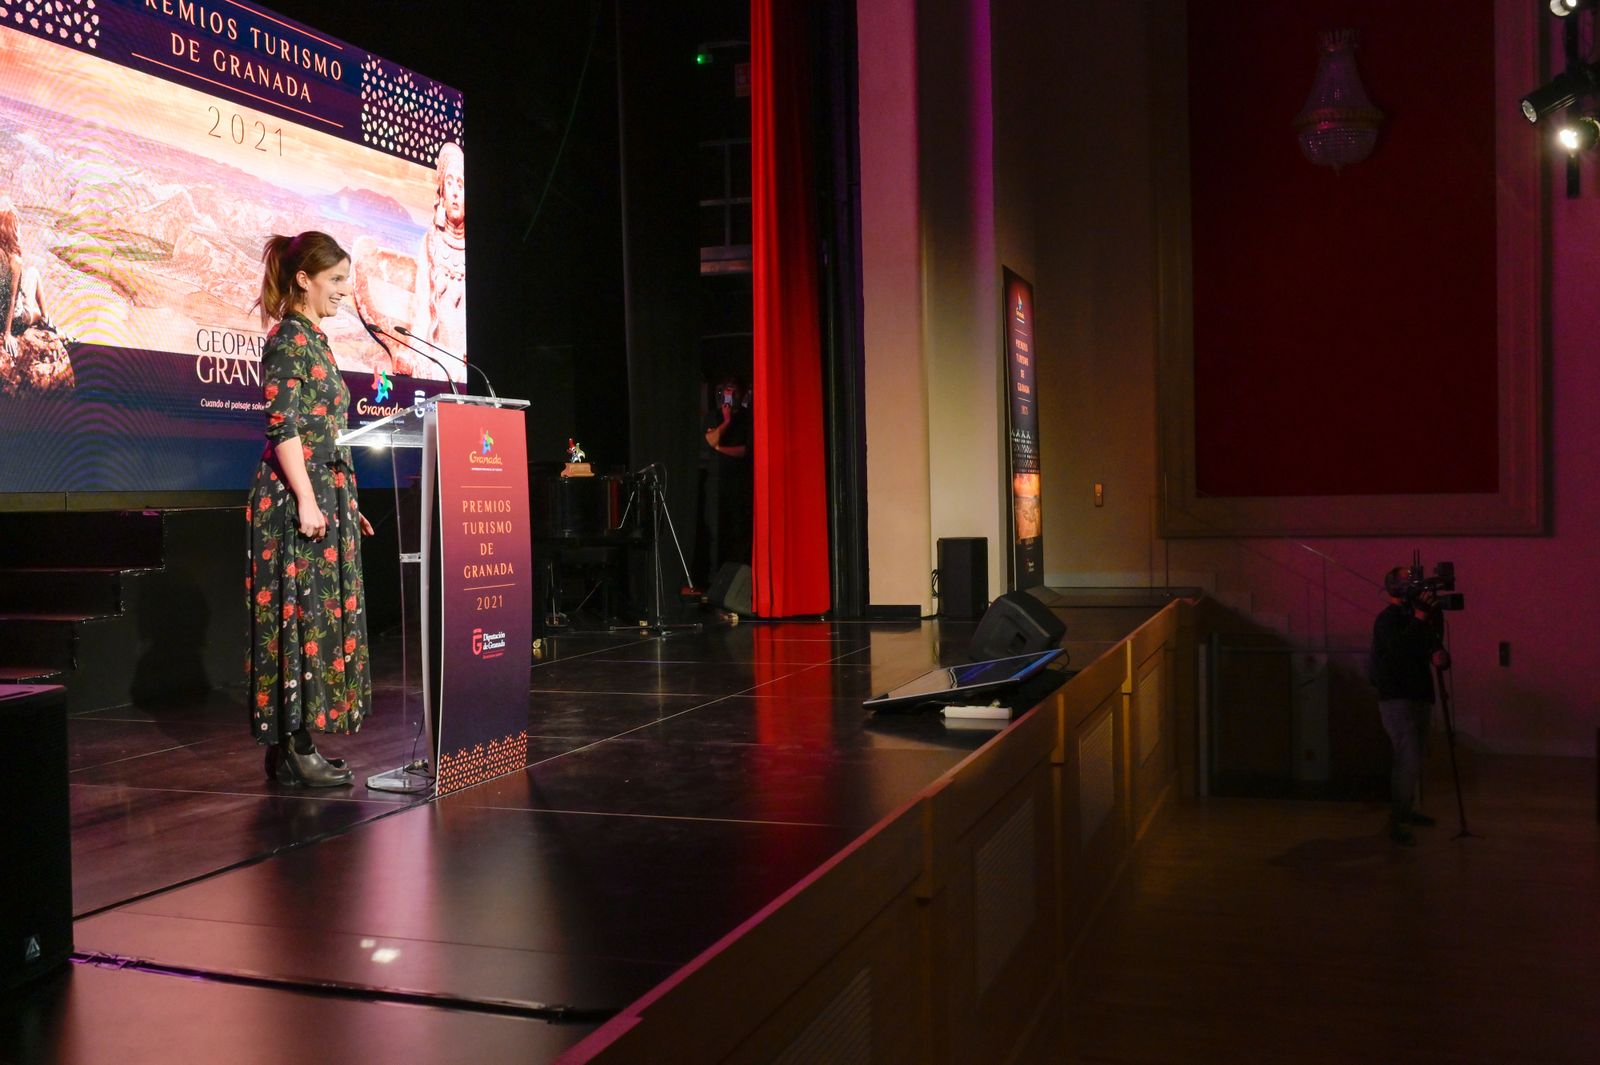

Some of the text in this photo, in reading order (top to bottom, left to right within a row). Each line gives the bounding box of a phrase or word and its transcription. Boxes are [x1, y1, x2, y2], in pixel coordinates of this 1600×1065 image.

[250, 27, 342, 81] TURISMO
[170, 32, 312, 104] DE GRANADA
[208, 105, 283, 157] 2021
[196, 355, 264, 388] GRAN
[200, 398, 224, 408] Cuando
[224, 400, 231, 409] el
[231, 400, 252, 412] paisaje
[469, 450, 503, 465] Granada
[462, 499, 512, 513] PREMIOS
[462, 520, 513, 535] TURISMO
[480, 542, 494, 556] DE
[463, 562, 514, 579] GRANADA
[476, 594, 503, 611] 2021
